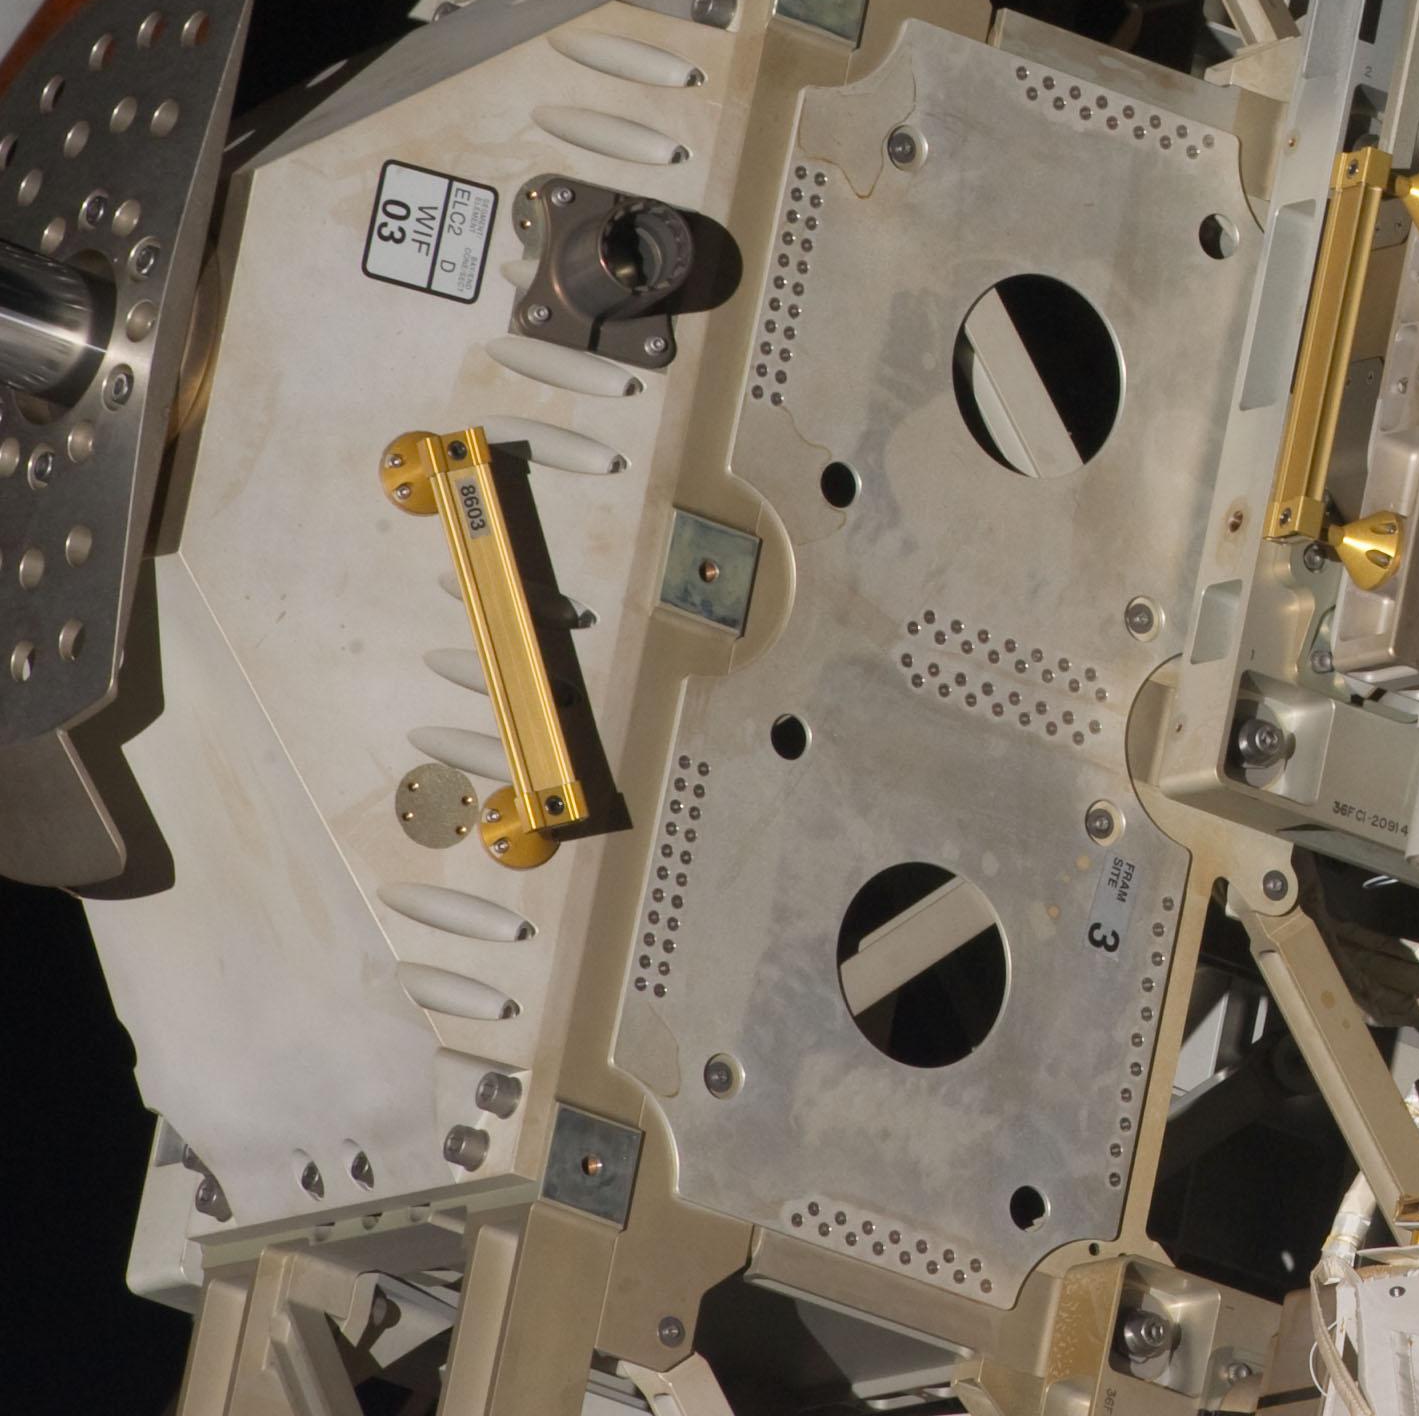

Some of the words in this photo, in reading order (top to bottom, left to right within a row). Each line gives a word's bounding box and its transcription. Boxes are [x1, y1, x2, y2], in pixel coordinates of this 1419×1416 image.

[376, 199, 411, 245] 03
[411, 206, 439, 257] WIF
[447, 187, 472, 236] ELC2
[440, 259, 457, 274] D
[461, 485, 485, 531] 8603
[1107, 857, 1124, 889] SITE
[1116, 861, 1136, 903] FRAM
[1088, 922, 1120, 953] 3
